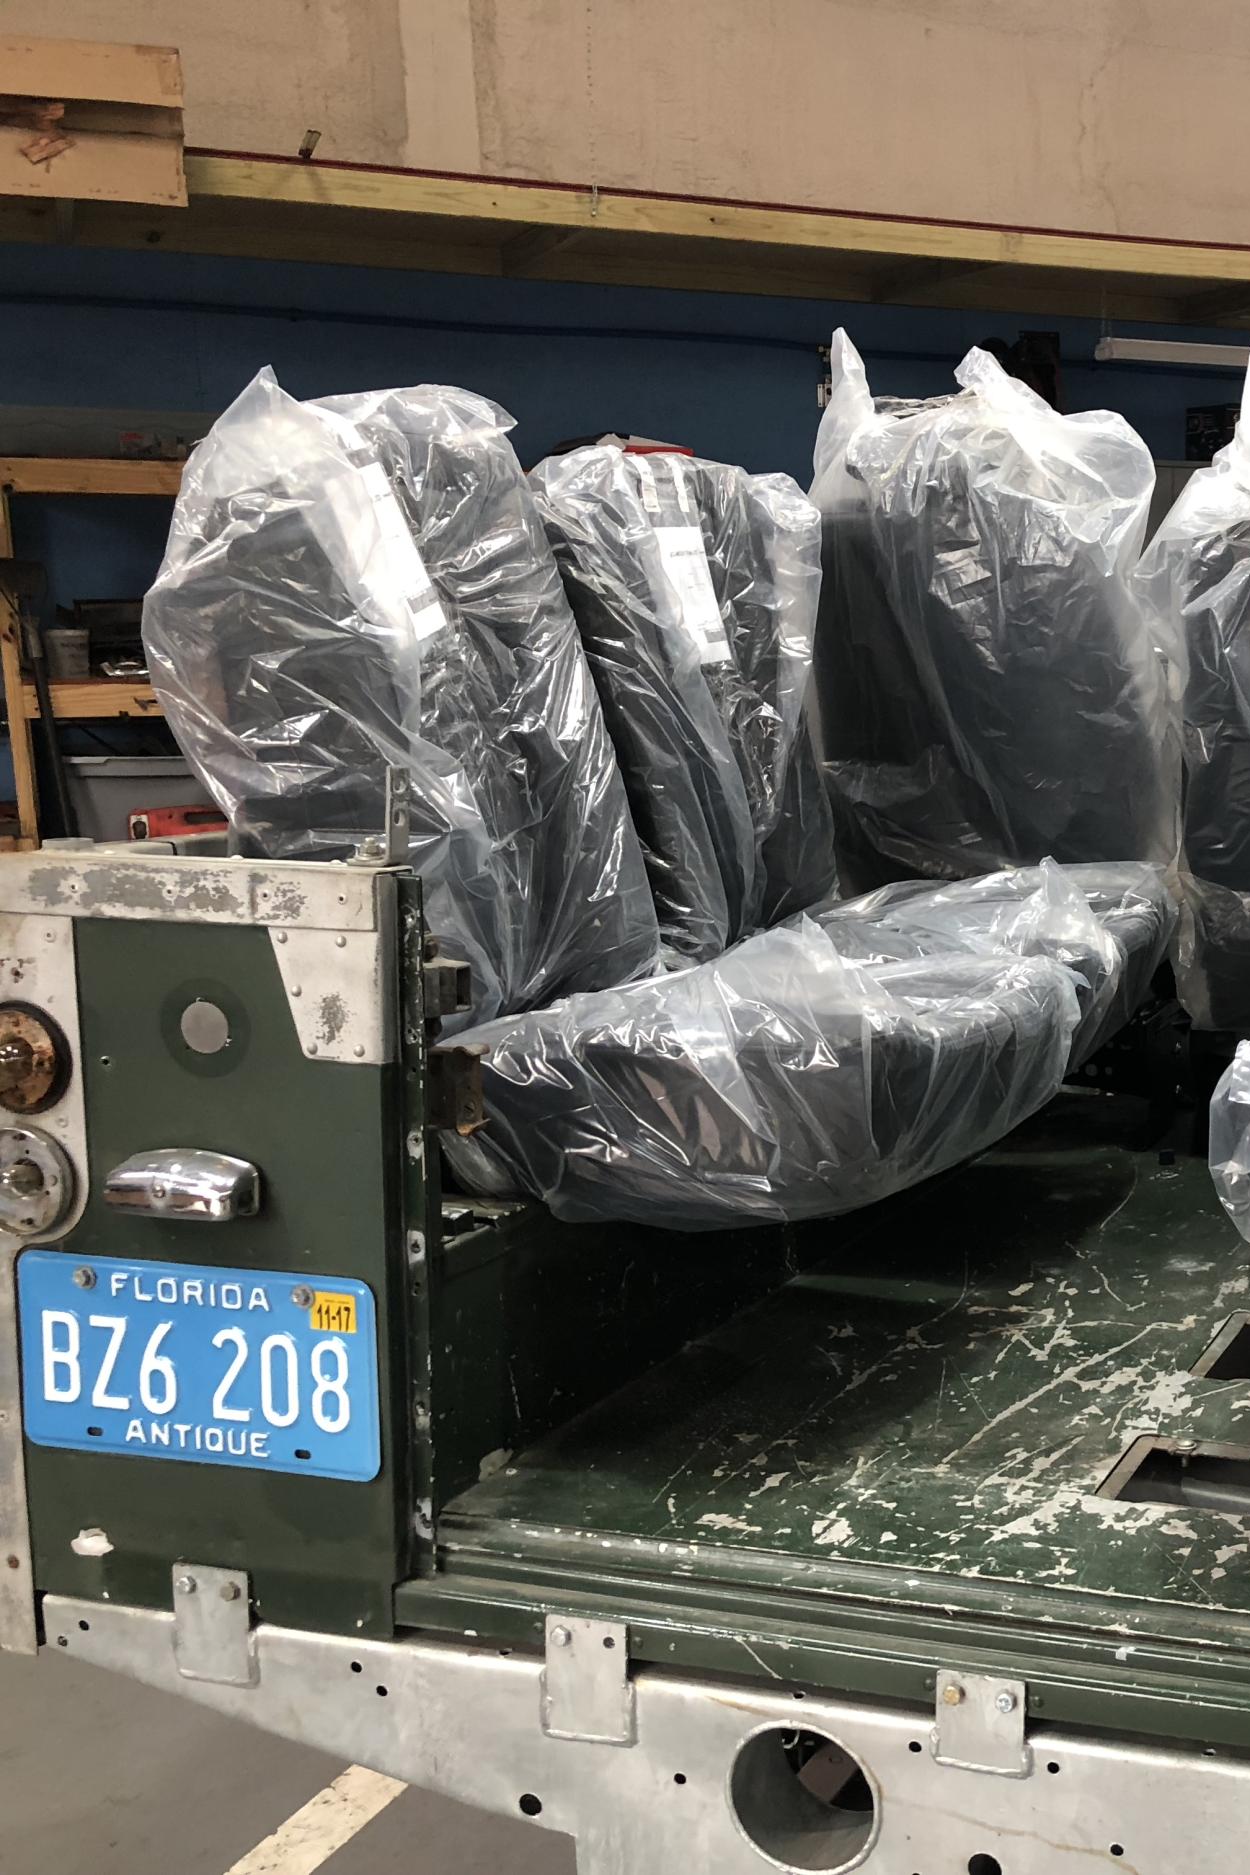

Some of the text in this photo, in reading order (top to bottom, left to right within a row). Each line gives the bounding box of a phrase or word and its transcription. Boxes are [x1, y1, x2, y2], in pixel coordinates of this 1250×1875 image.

[111, 1271, 270, 1312] FLORIDA
[41, 1309, 351, 1434] BZ6 208
[125, 1418, 271, 1459] ANTIQUE
